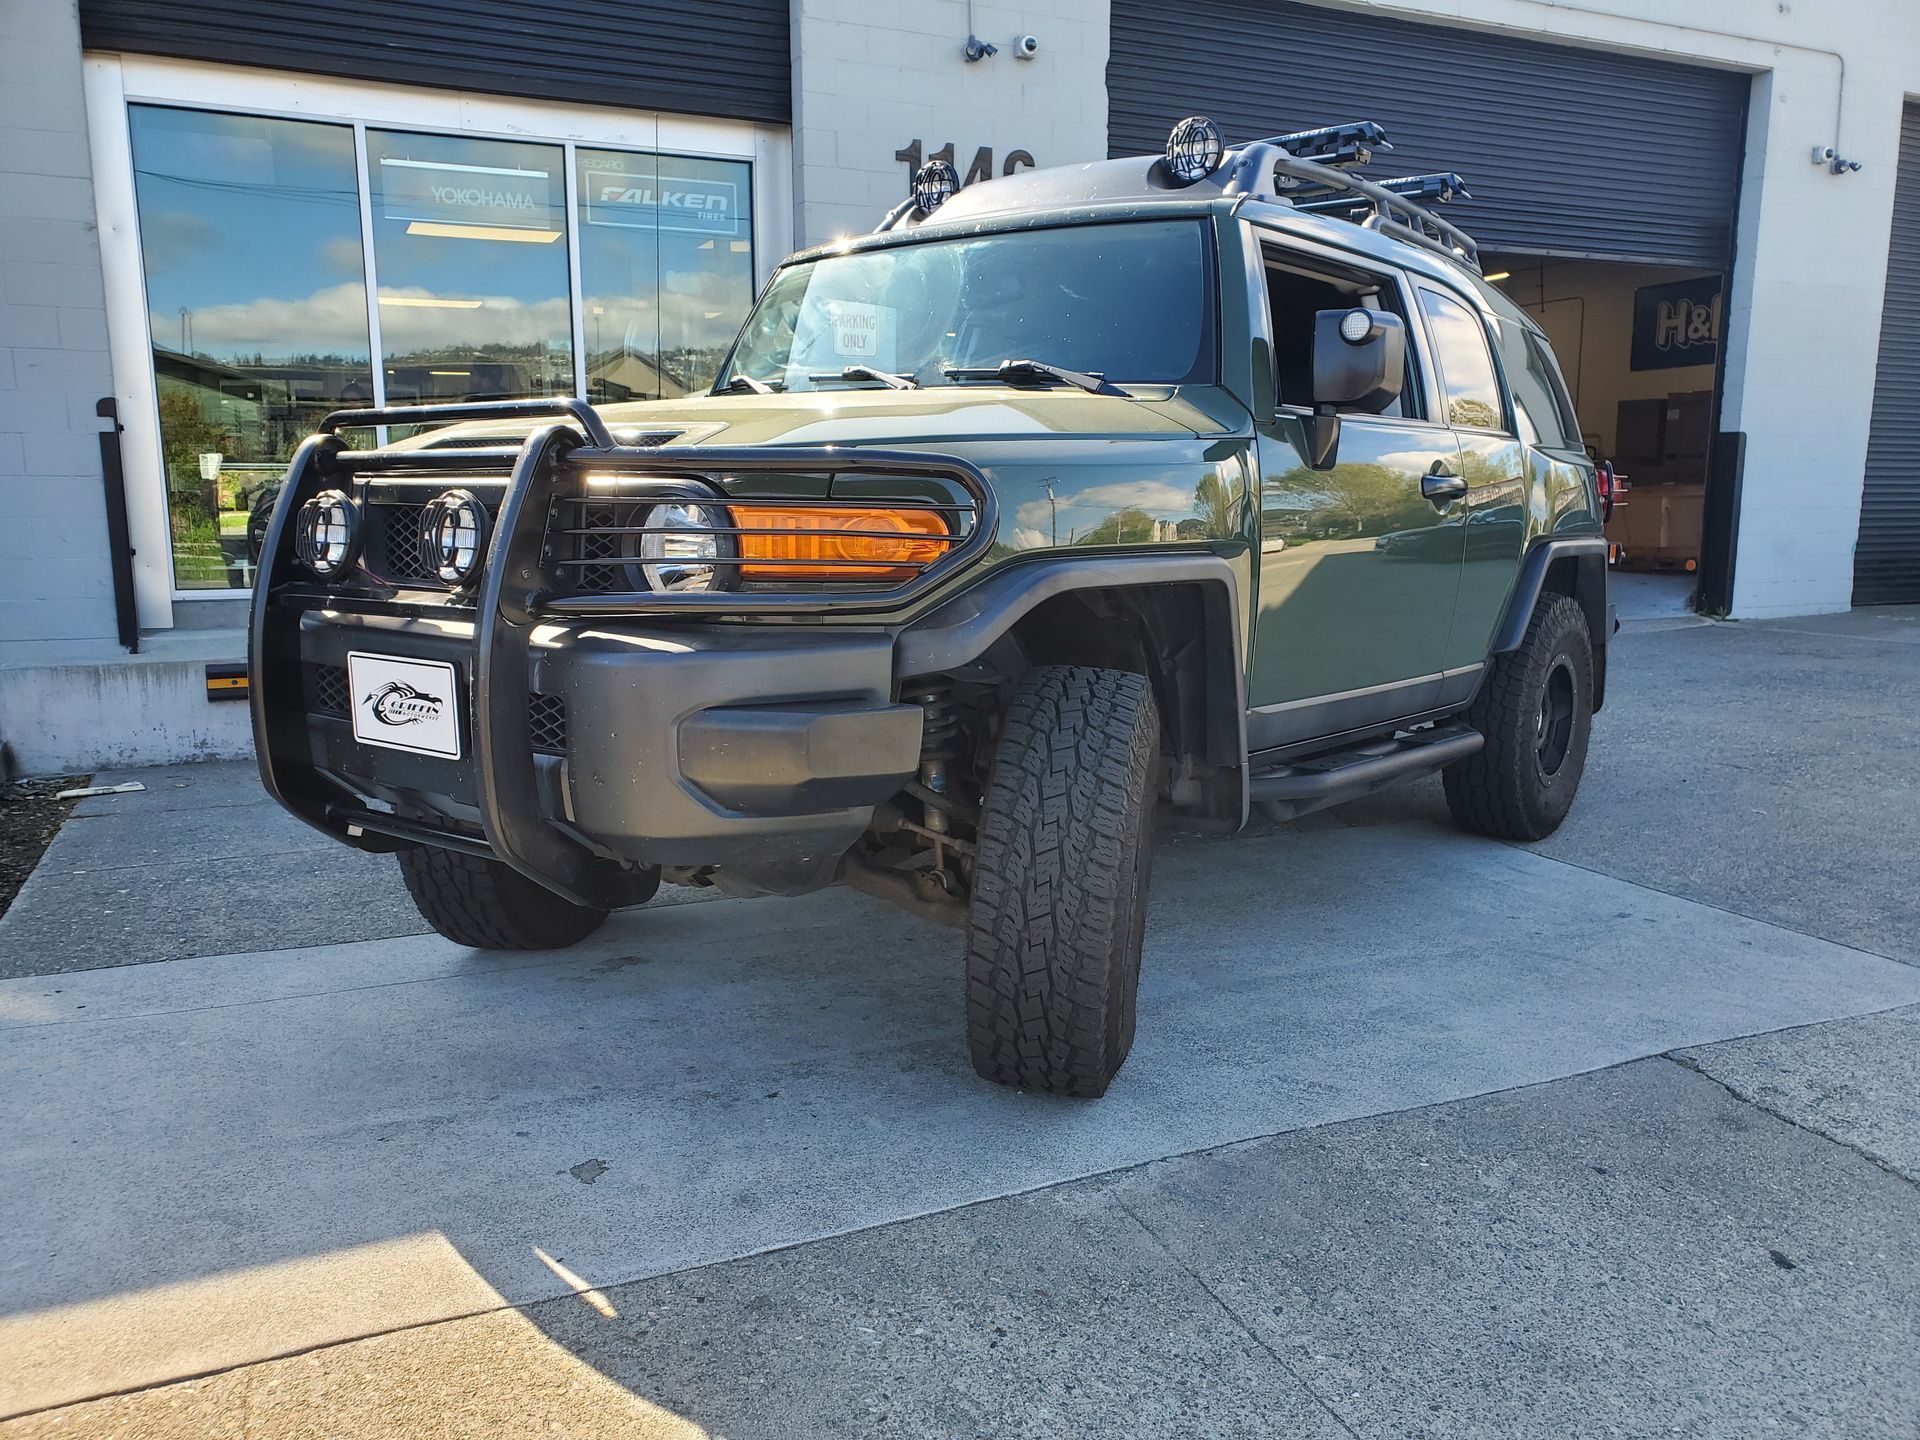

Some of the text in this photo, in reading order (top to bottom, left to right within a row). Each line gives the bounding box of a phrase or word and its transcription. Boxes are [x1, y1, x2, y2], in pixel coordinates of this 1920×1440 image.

[430, 185, 536, 210] YOKOHAMA
[601, 186, 728, 211] FALKEN
[697, 211, 726, 222] TIRES
[833, 313, 876, 330] PARKING
[843, 333, 868, 349] ONLY
[390, 700, 440, 714] GRIFFIN
